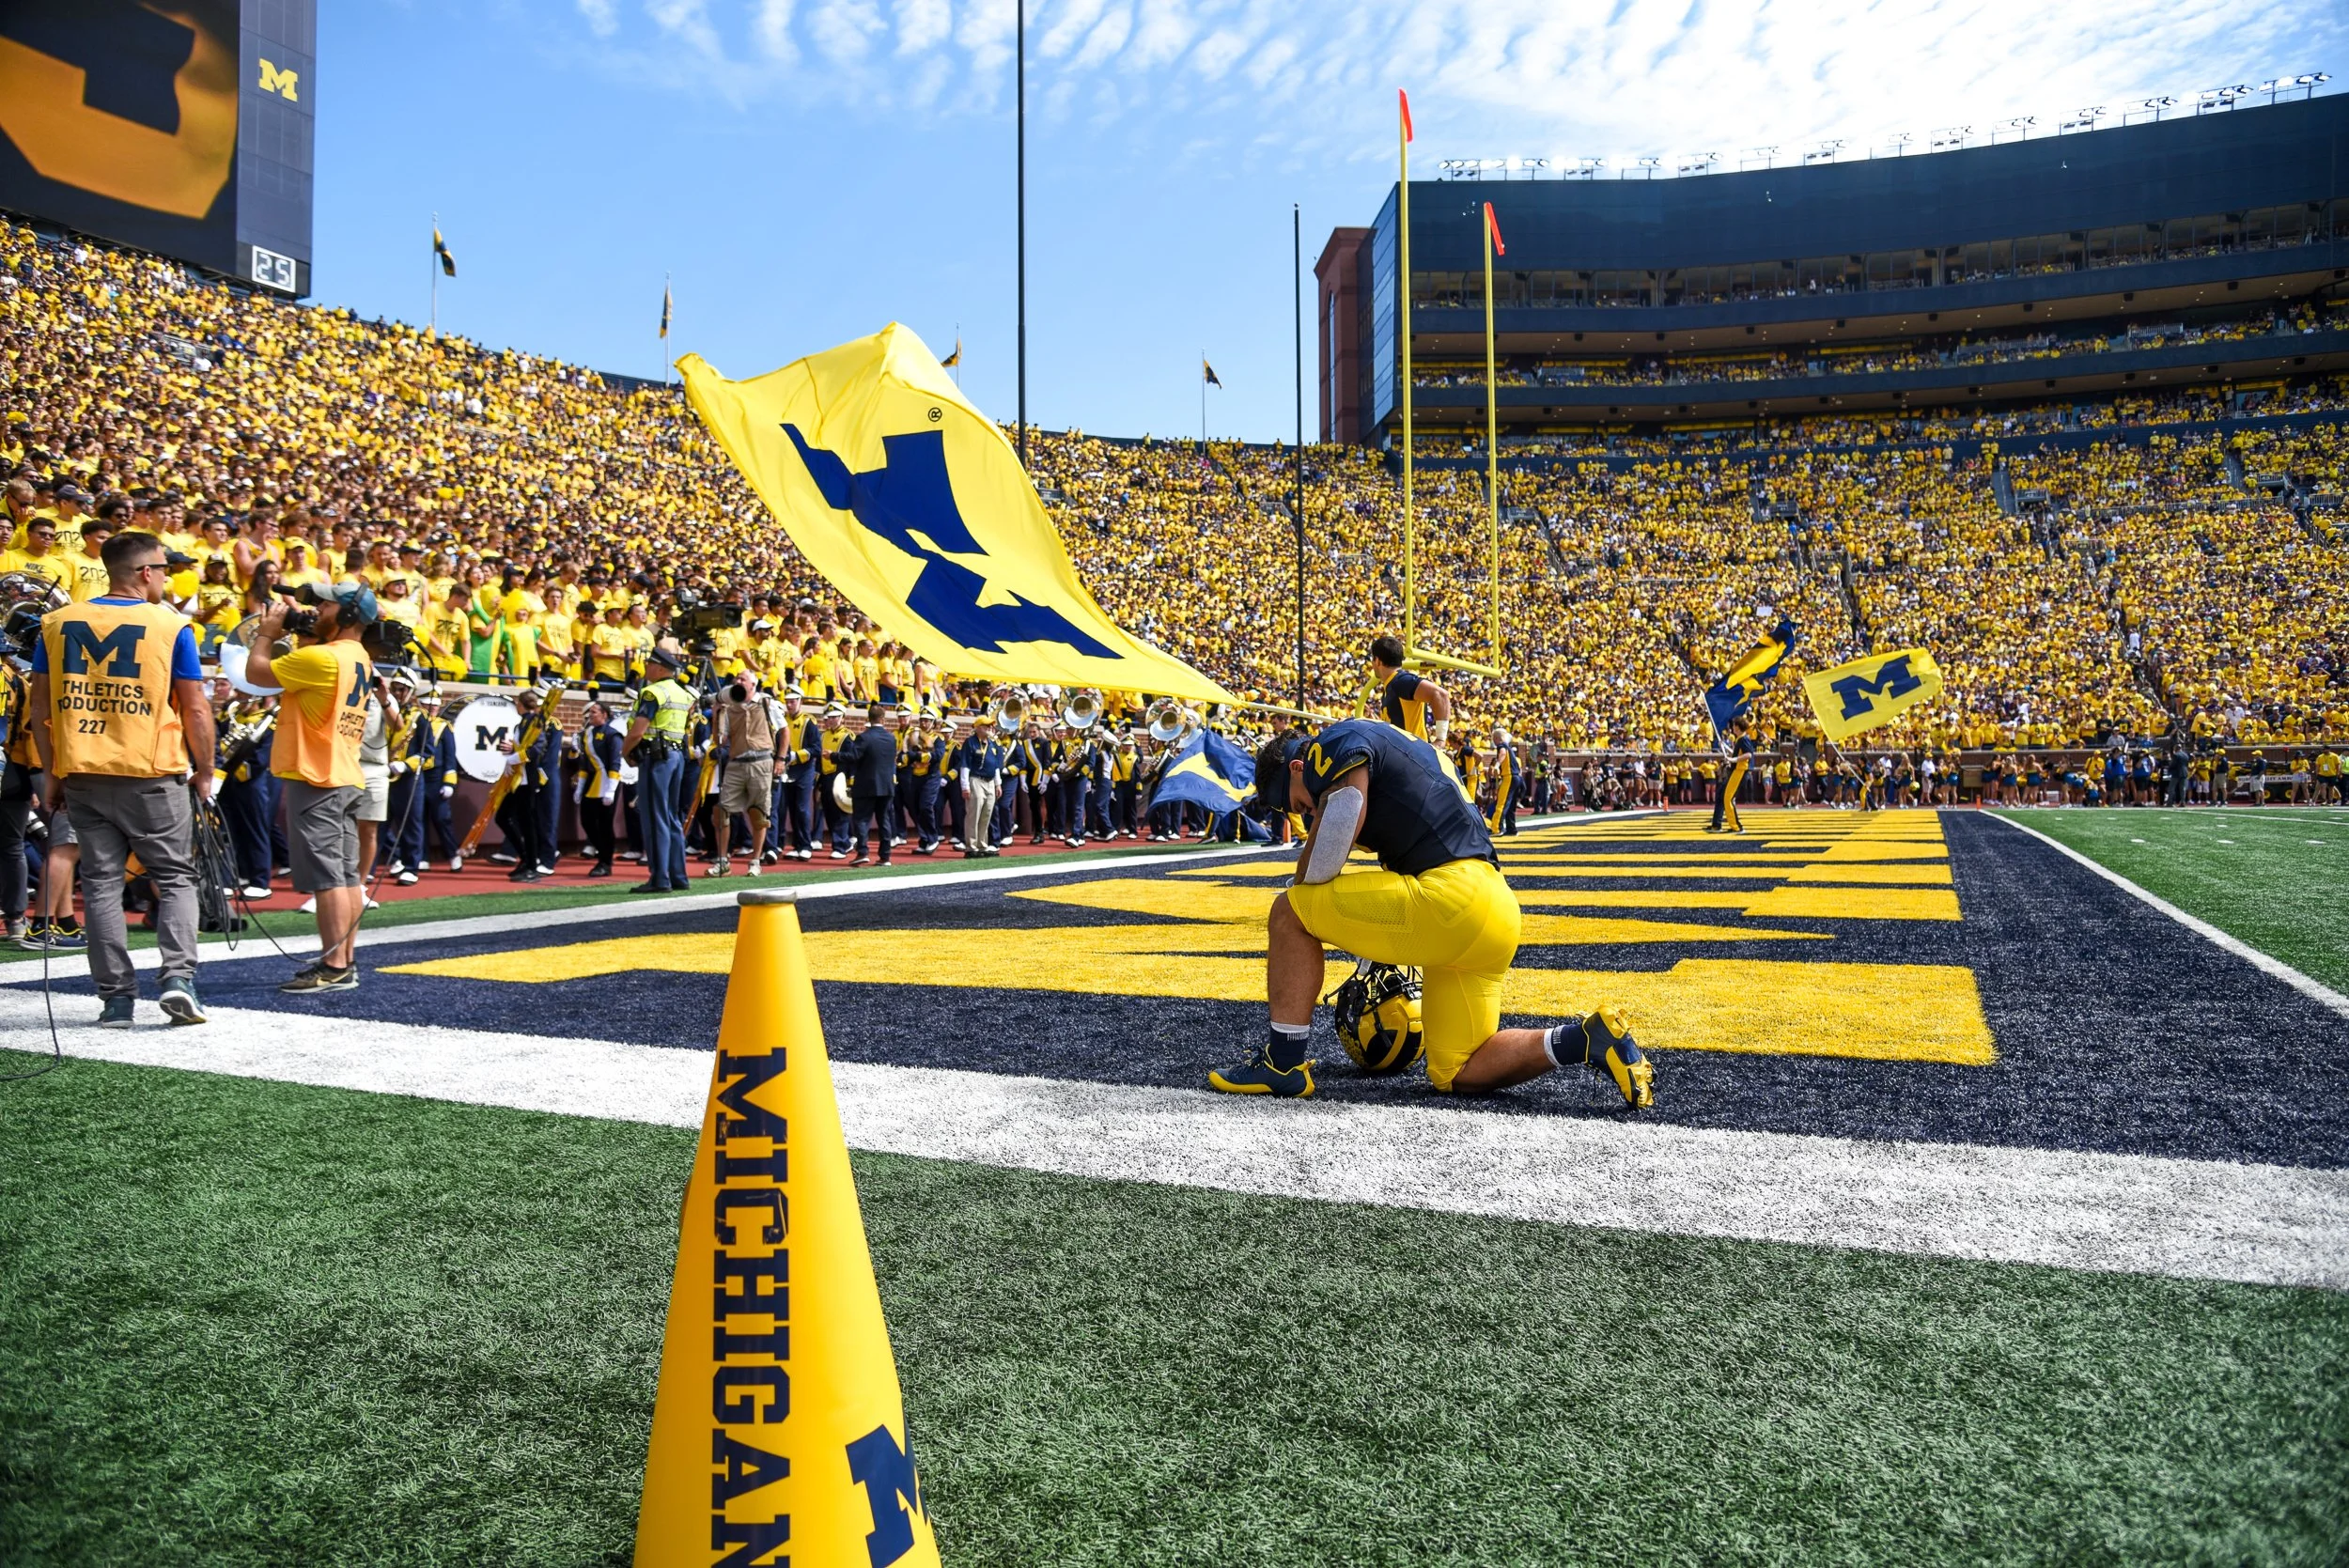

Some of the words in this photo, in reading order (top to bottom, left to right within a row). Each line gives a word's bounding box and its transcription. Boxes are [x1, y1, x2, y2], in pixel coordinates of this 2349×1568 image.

[258, 58, 298, 102] M
[257, 252, 290, 286] 25
[60, 621, 146, 678] M
[1829, 654, 1921, 722] M
[78, 719, 107, 735] 227
[475, 725, 508, 751] M
[1308, 742, 1332, 778] 2
[710, 1047, 790, 1568] MICHIGAN
